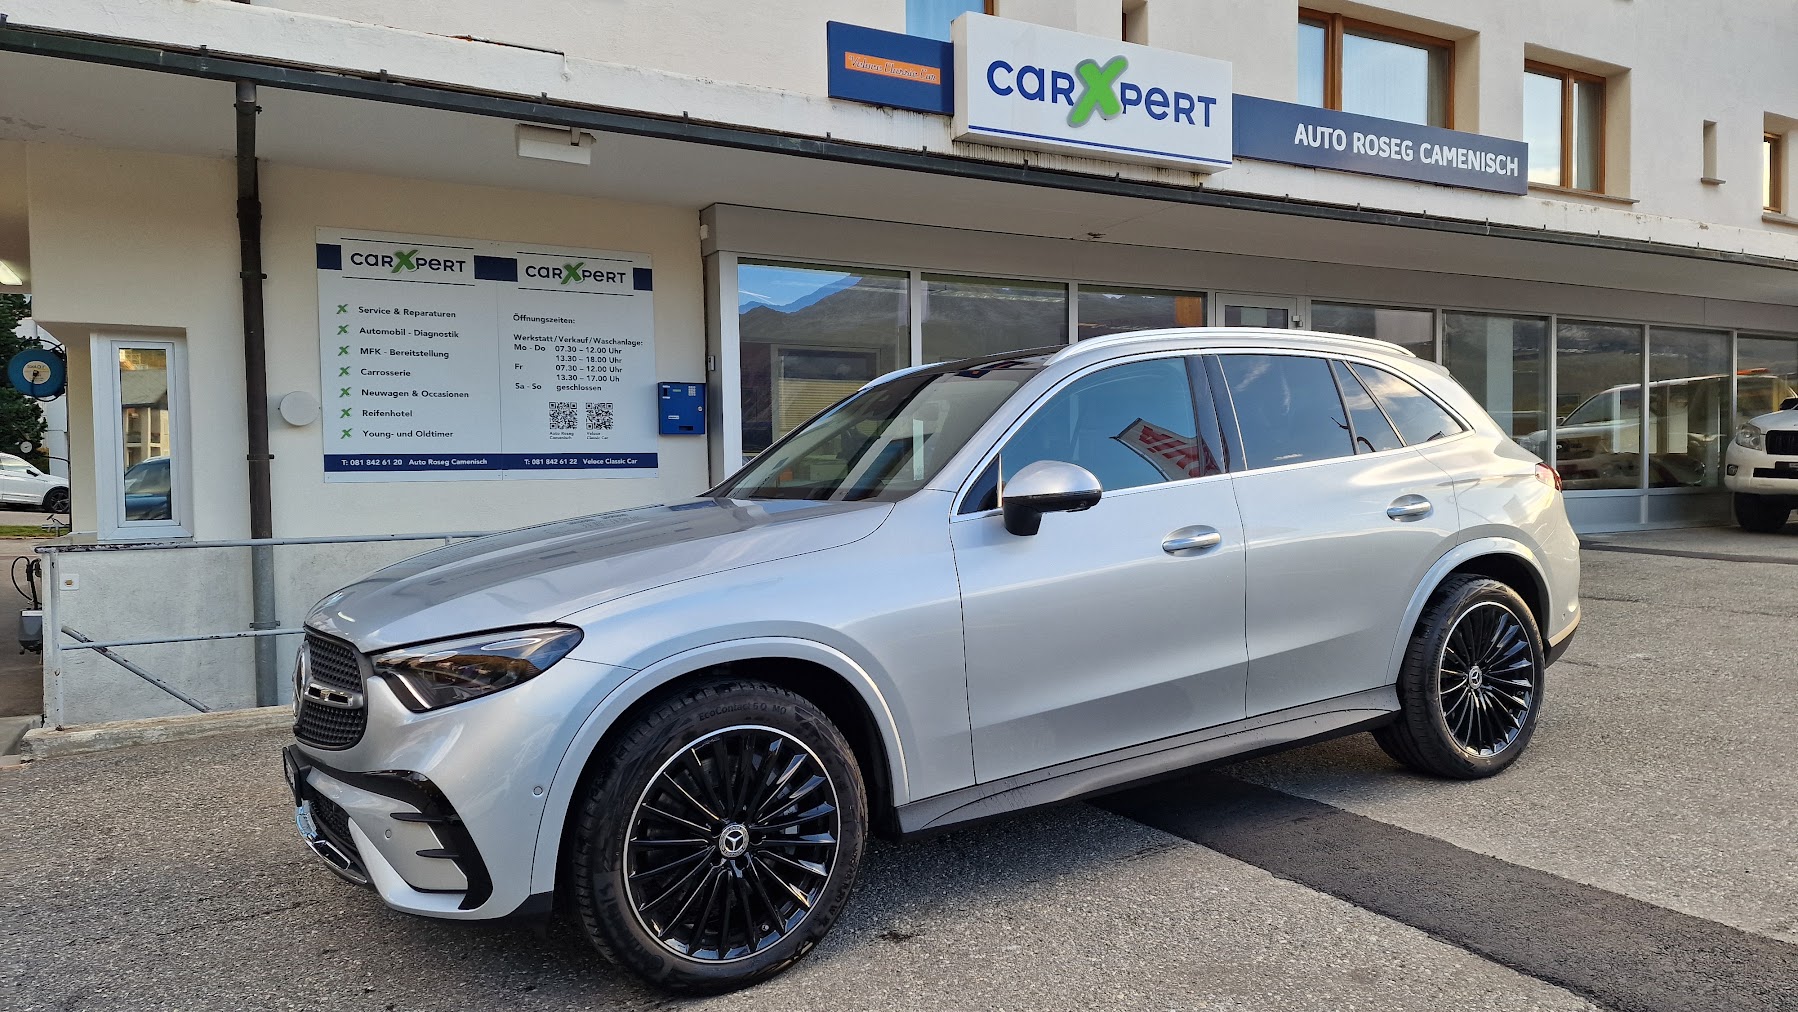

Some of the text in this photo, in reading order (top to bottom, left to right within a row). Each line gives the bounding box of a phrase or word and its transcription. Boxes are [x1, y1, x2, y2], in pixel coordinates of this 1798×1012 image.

[1295, 123, 1518, 176] AUTO ROSEG CAMENISCH
[358, 306, 391, 315] Service
[403, 308, 456, 318] Reparaturen
[513, 313, 575, 325] Öffnungszeiten:
[359, 327, 406, 336] Automobil
[414, 329, 459, 339] Diagnostik
[390, 349, 450, 359] Bereitstellung
[360, 368, 411, 377] Carrosserie
[556, 384, 602, 392] geschlossen
[361, 389, 409, 398] Neuwagen
[363, 430, 453, 439] Young- und Oldtimer
[428, 459, 450, 467] Roseg
